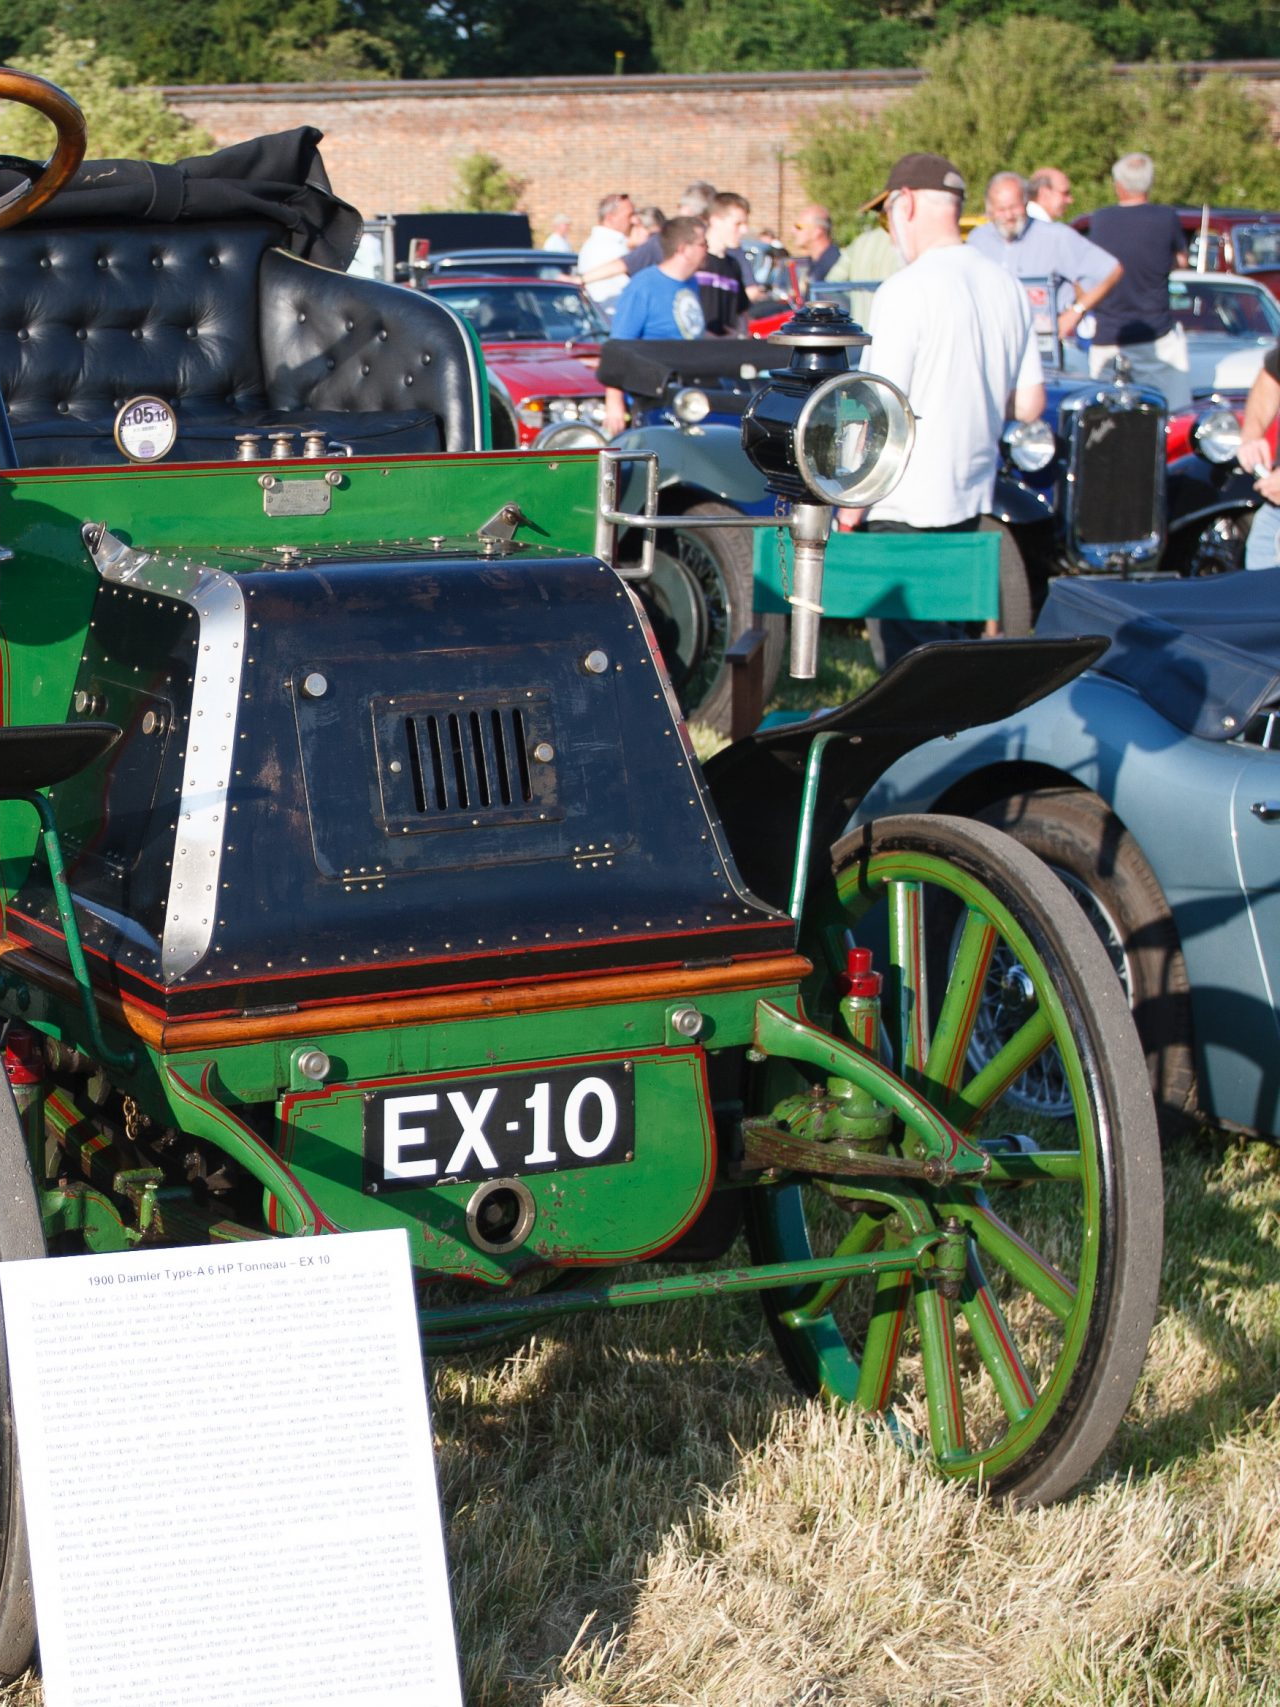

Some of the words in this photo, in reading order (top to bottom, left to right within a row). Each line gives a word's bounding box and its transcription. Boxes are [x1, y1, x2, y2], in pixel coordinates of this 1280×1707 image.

[133, 407, 153, 424] 05
[154, 410, 168, 422] 10
[88, 1274, 114, 1286] 1900
[117, 1269, 161, 1283] Daimler
[163, 1265, 206, 1281] Type-A
[206, 1264, 215, 1275] 6
[216, 1263, 234, 1274] HP
[236, 1258, 286, 1272] Tonneau
[298, 1255, 314, 1266] EX
[316, 1254, 330, 1265] 10
